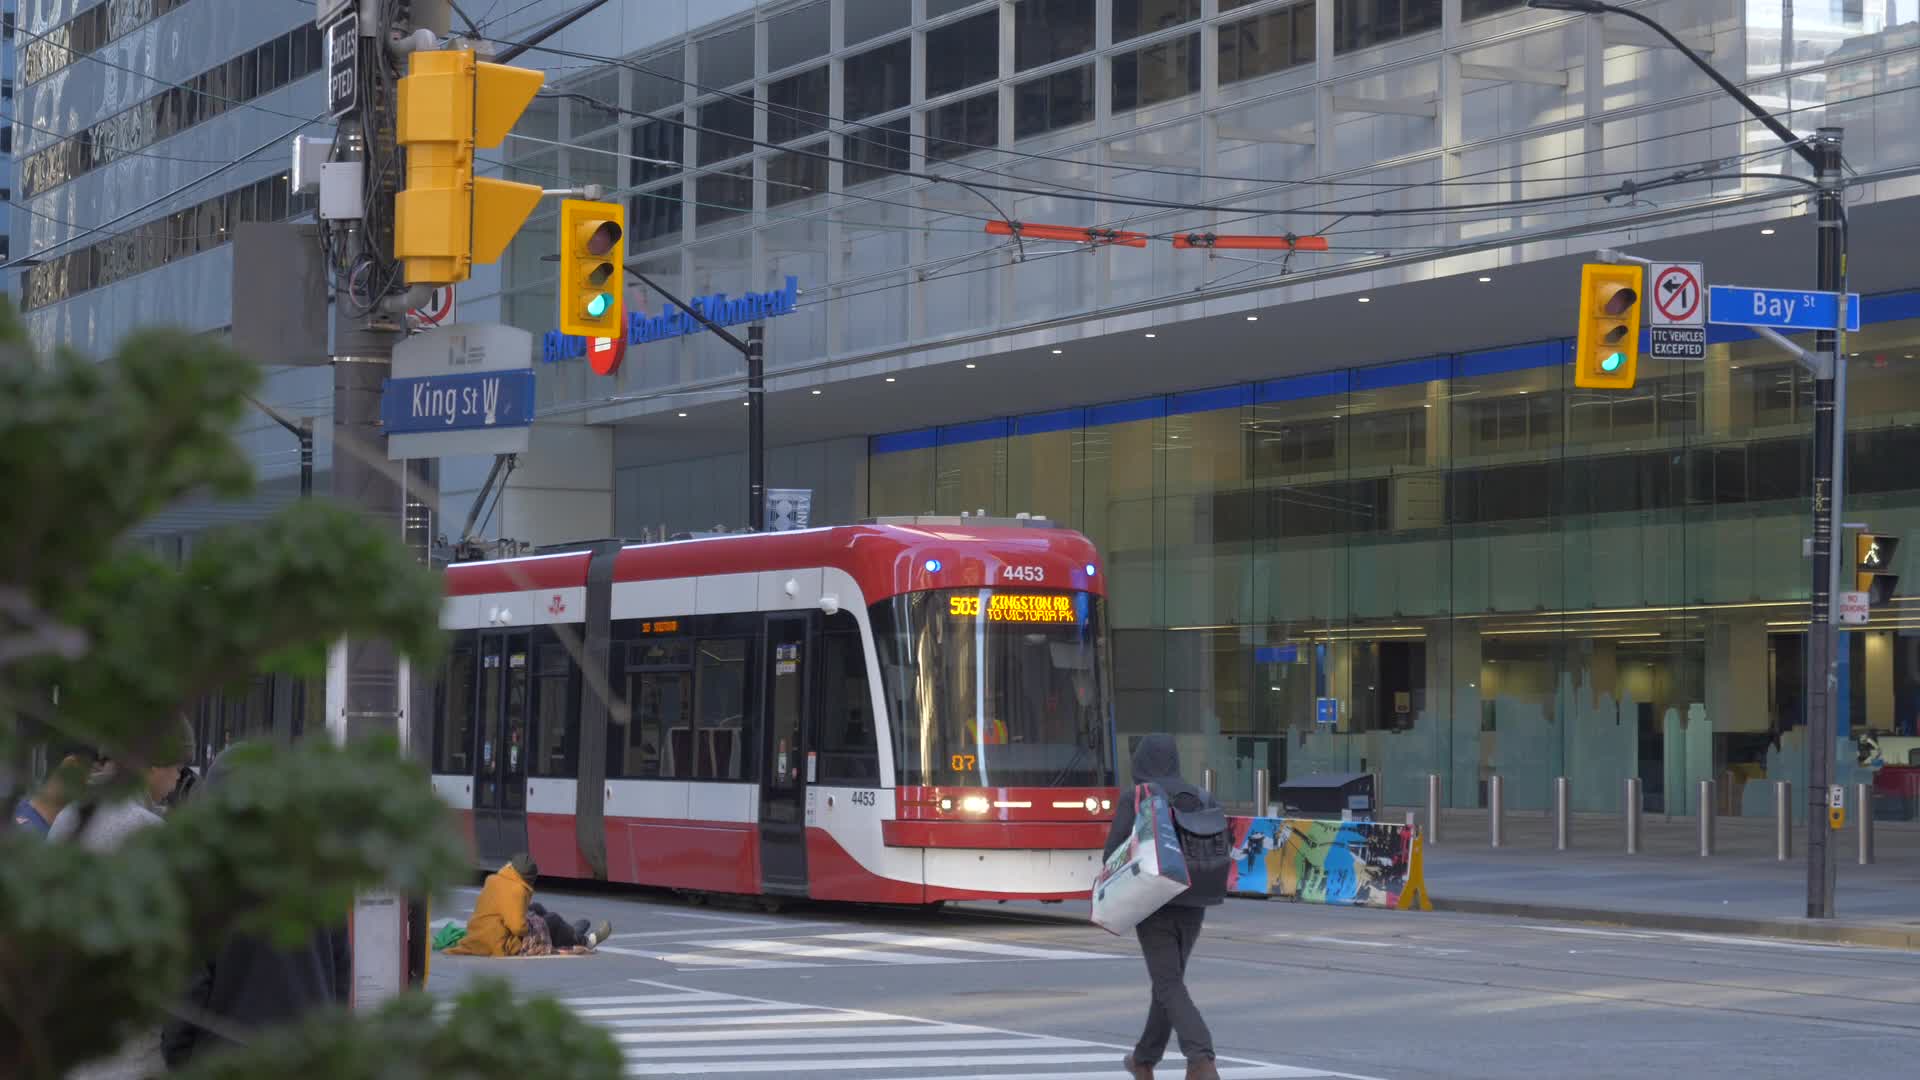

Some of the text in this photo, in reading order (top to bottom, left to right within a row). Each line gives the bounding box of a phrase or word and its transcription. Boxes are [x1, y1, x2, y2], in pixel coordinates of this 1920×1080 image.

[1753, 292, 1816, 323] Bay St
[1653, 330, 1704, 342] TTC VEHICLES
[1655, 344, 1702, 355] EXCEPTED
[412, 377, 500, 425] King St W
[1003, 566, 1045, 582] 4453
[950, 595, 1070, 616] 503 KINGSTON RD
[987, 608, 1075, 622] TO VICTORIA PK
[951, 754, 976, 772] 07
[851, 791, 876, 807] 4453
